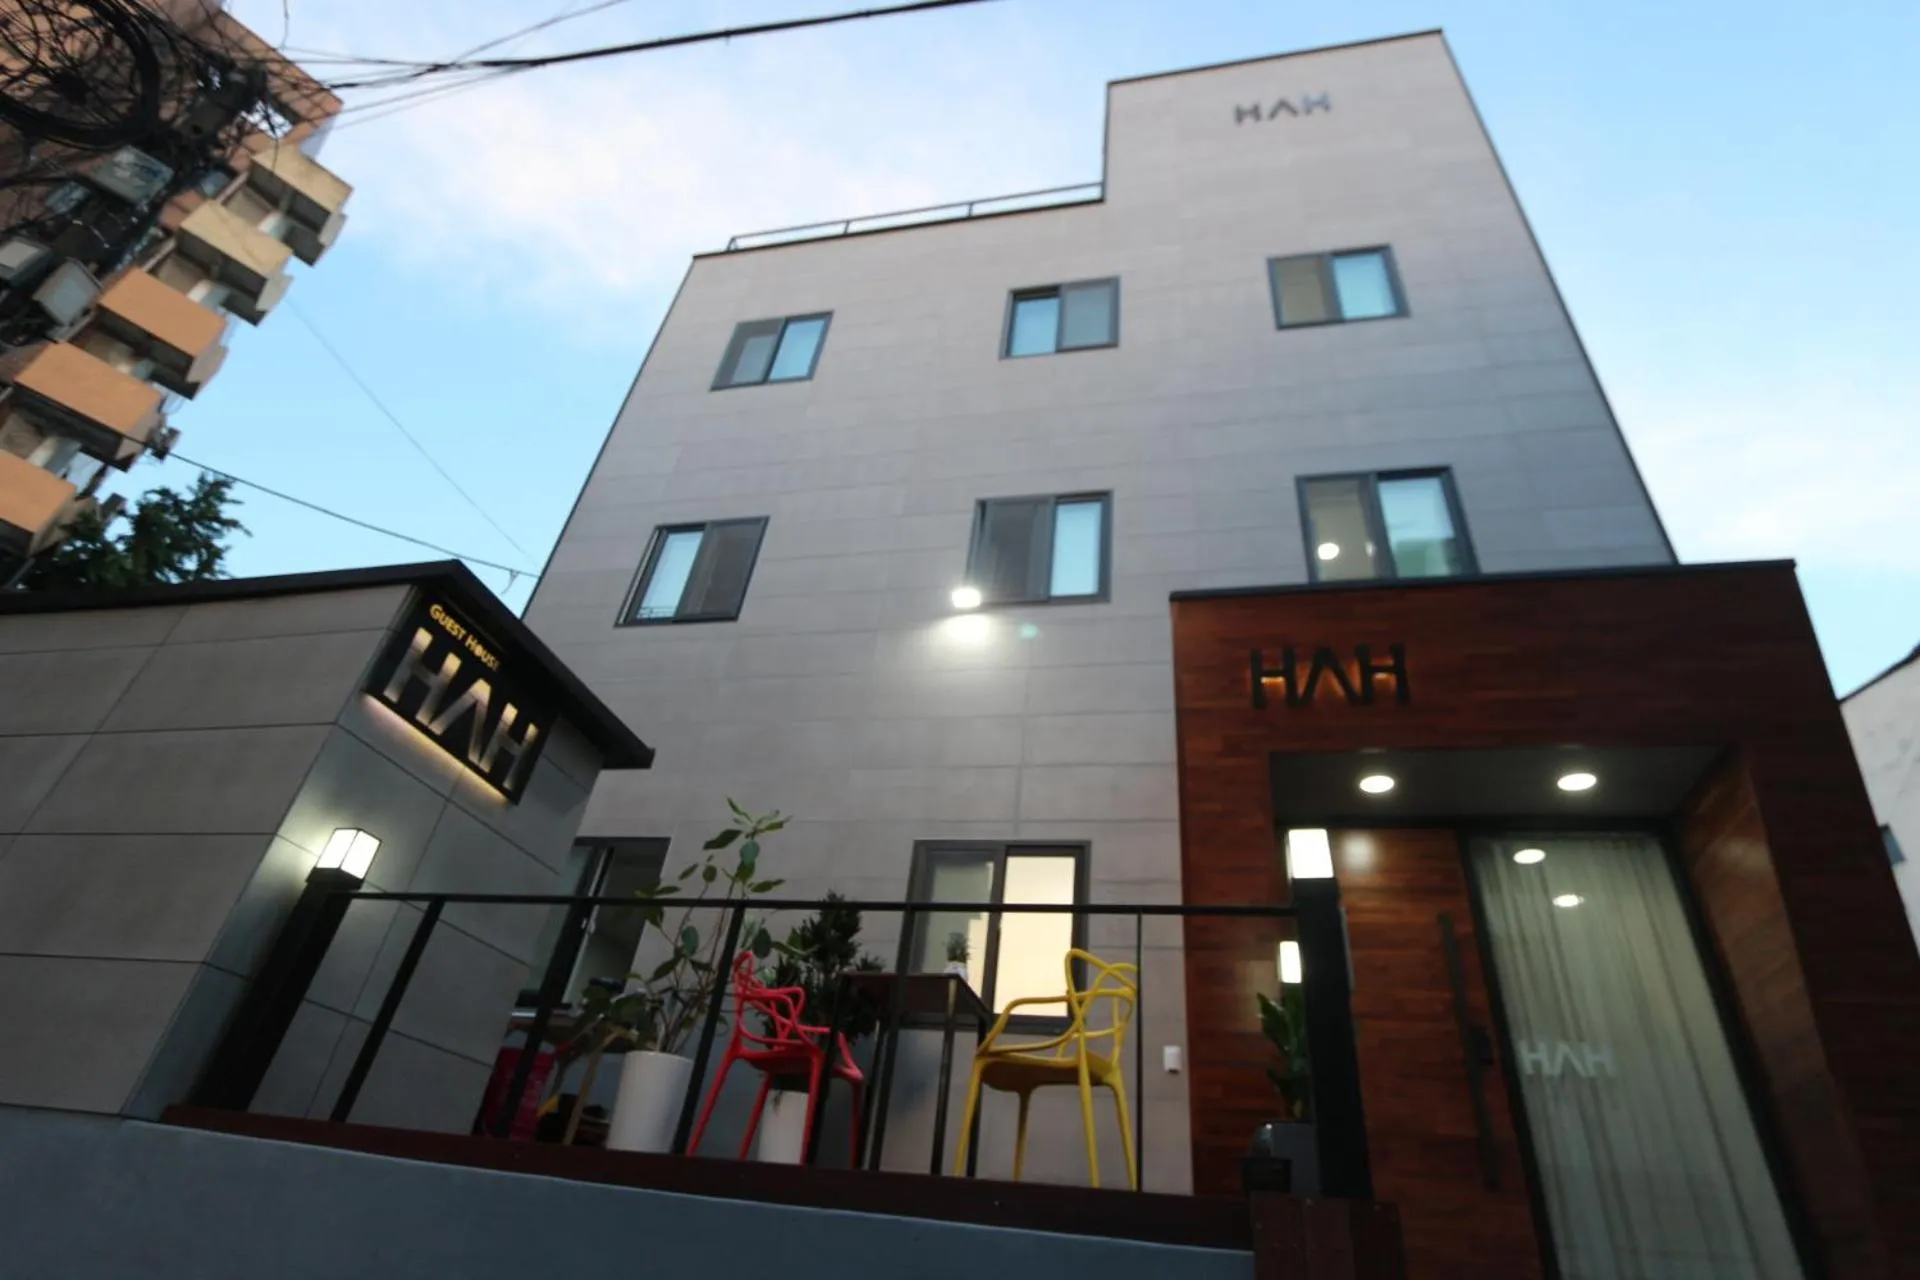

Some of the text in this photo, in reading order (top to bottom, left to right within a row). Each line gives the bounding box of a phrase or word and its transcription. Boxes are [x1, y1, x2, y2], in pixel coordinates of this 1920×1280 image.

[430, 604, 466, 640] GUEST
[383, 627, 540, 791] HAH
[1251, 643, 1409, 709] HAH
